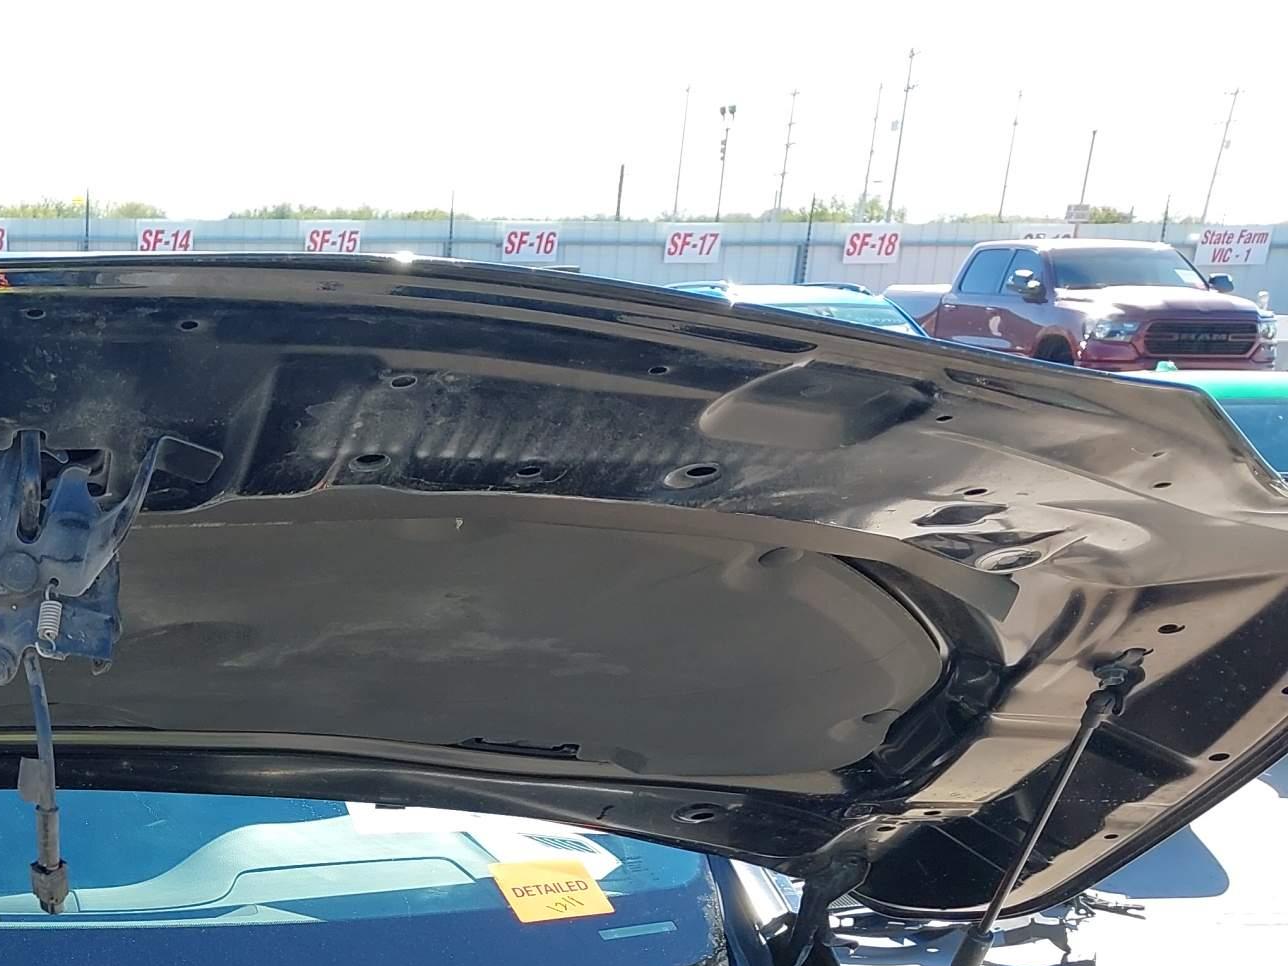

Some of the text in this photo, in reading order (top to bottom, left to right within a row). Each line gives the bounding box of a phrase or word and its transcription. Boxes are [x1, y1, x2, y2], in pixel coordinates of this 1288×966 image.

[140, 229, 191, 251] SF-14
[307, 230, 359, 252] SF-15
[505, 231, 557, 255] SF-16
[667, 232, 720, 256] SF-17
[846, 232, 899, 256] SF-18
[1201, 229, 1269, 245] State Farm
[1211, 247, 1233, 263] VIC
[1244, 248, 1252, 263] 1
[511, 880, 589, 898] DETAILED
